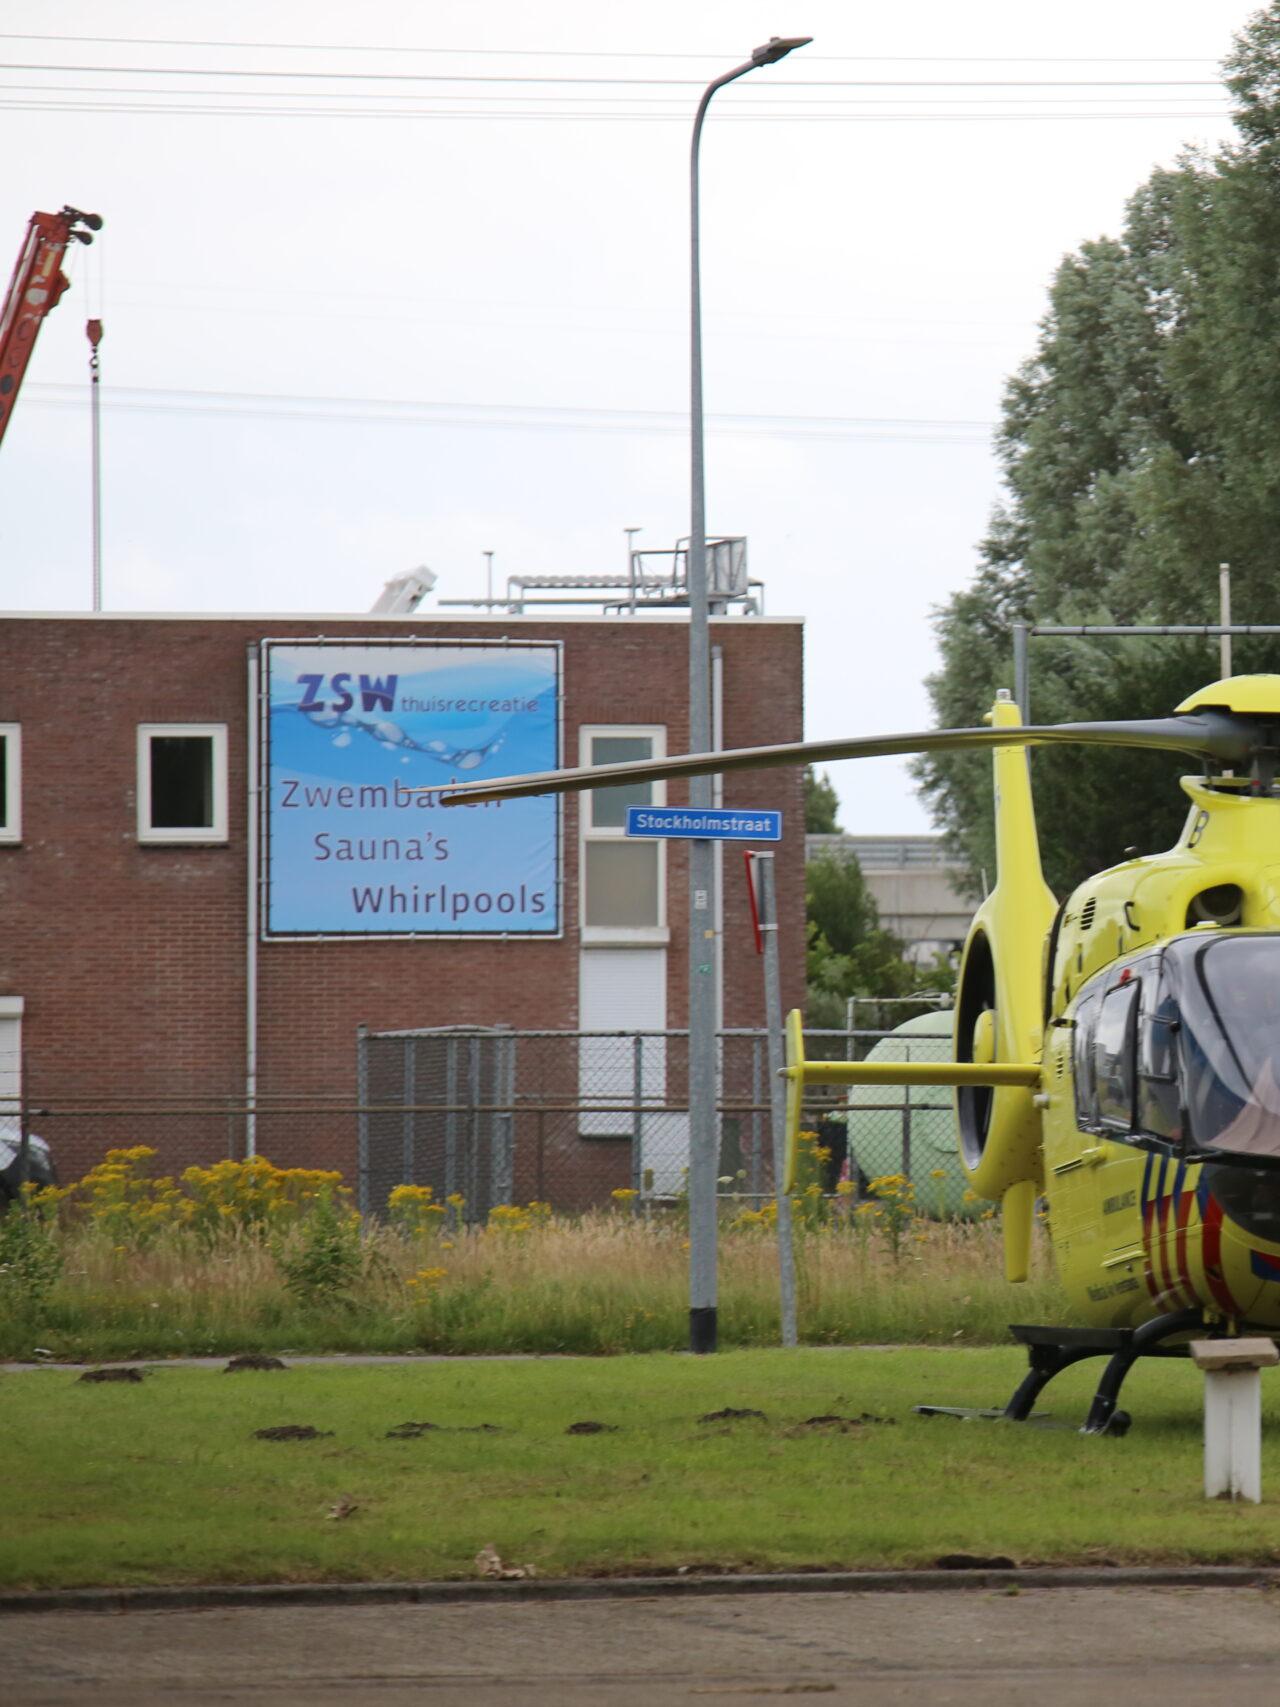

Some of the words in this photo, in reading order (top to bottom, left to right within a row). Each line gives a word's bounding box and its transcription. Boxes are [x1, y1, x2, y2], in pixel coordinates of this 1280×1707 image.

[297, 673, 398, 712] ZSW
[402, 696, 539, 713] thuisrecreatie
[281, 779, 502, 808] Zwembad
[637, 813, 772, 832] Stockholmstraat
[352, 884, 545, 921] Whirlpools
